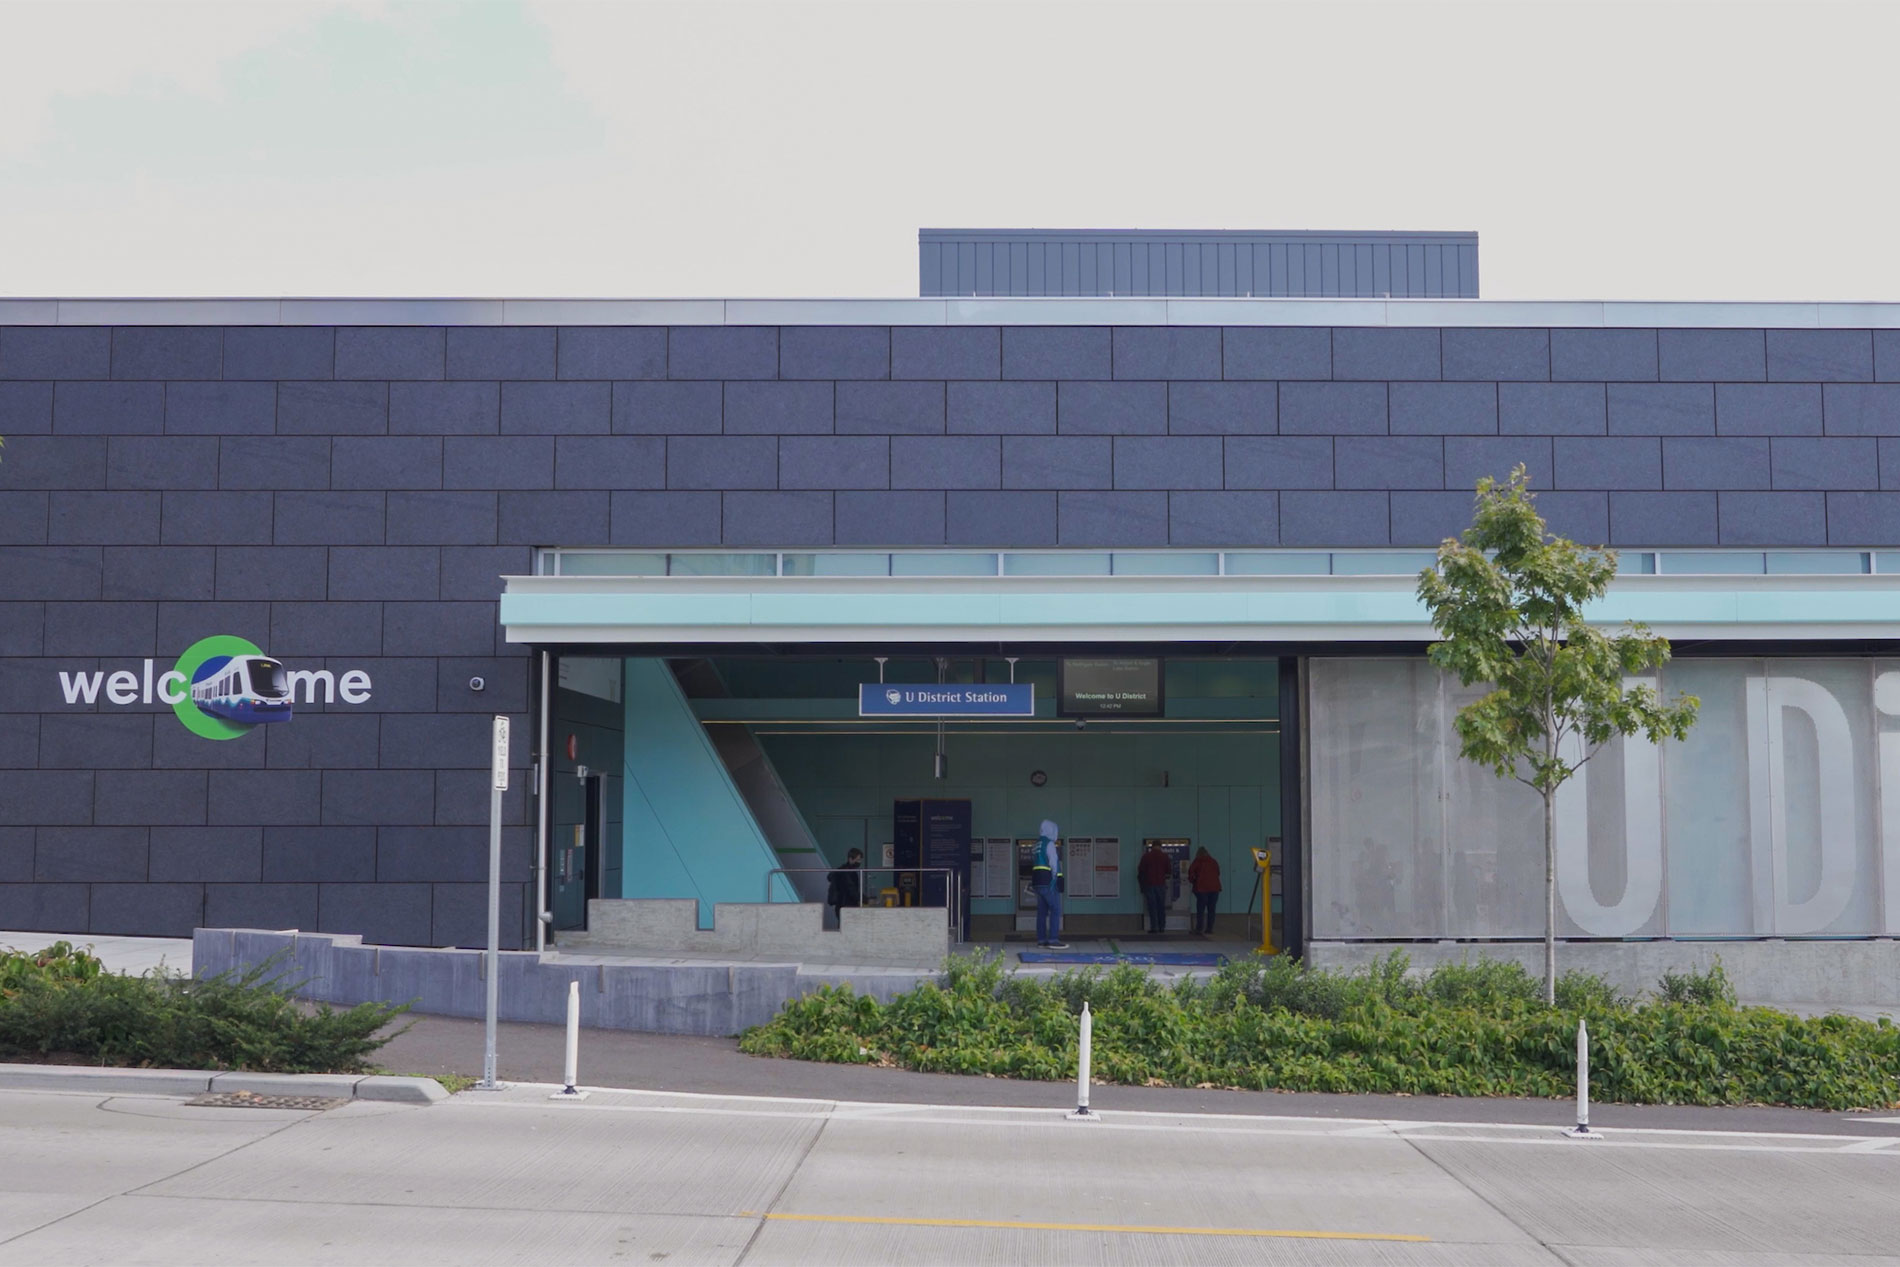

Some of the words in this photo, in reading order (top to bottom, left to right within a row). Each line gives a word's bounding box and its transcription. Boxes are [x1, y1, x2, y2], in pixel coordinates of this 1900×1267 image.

[905, 691, 915, 703] U
[918, 690, 961, 703] District
[965, 690, 1007, 703] Station
[1075, 692, 1106, 700] Welcome
[1122, 692, 1146, 700] District
[1552, 675, 1662, 936] U
